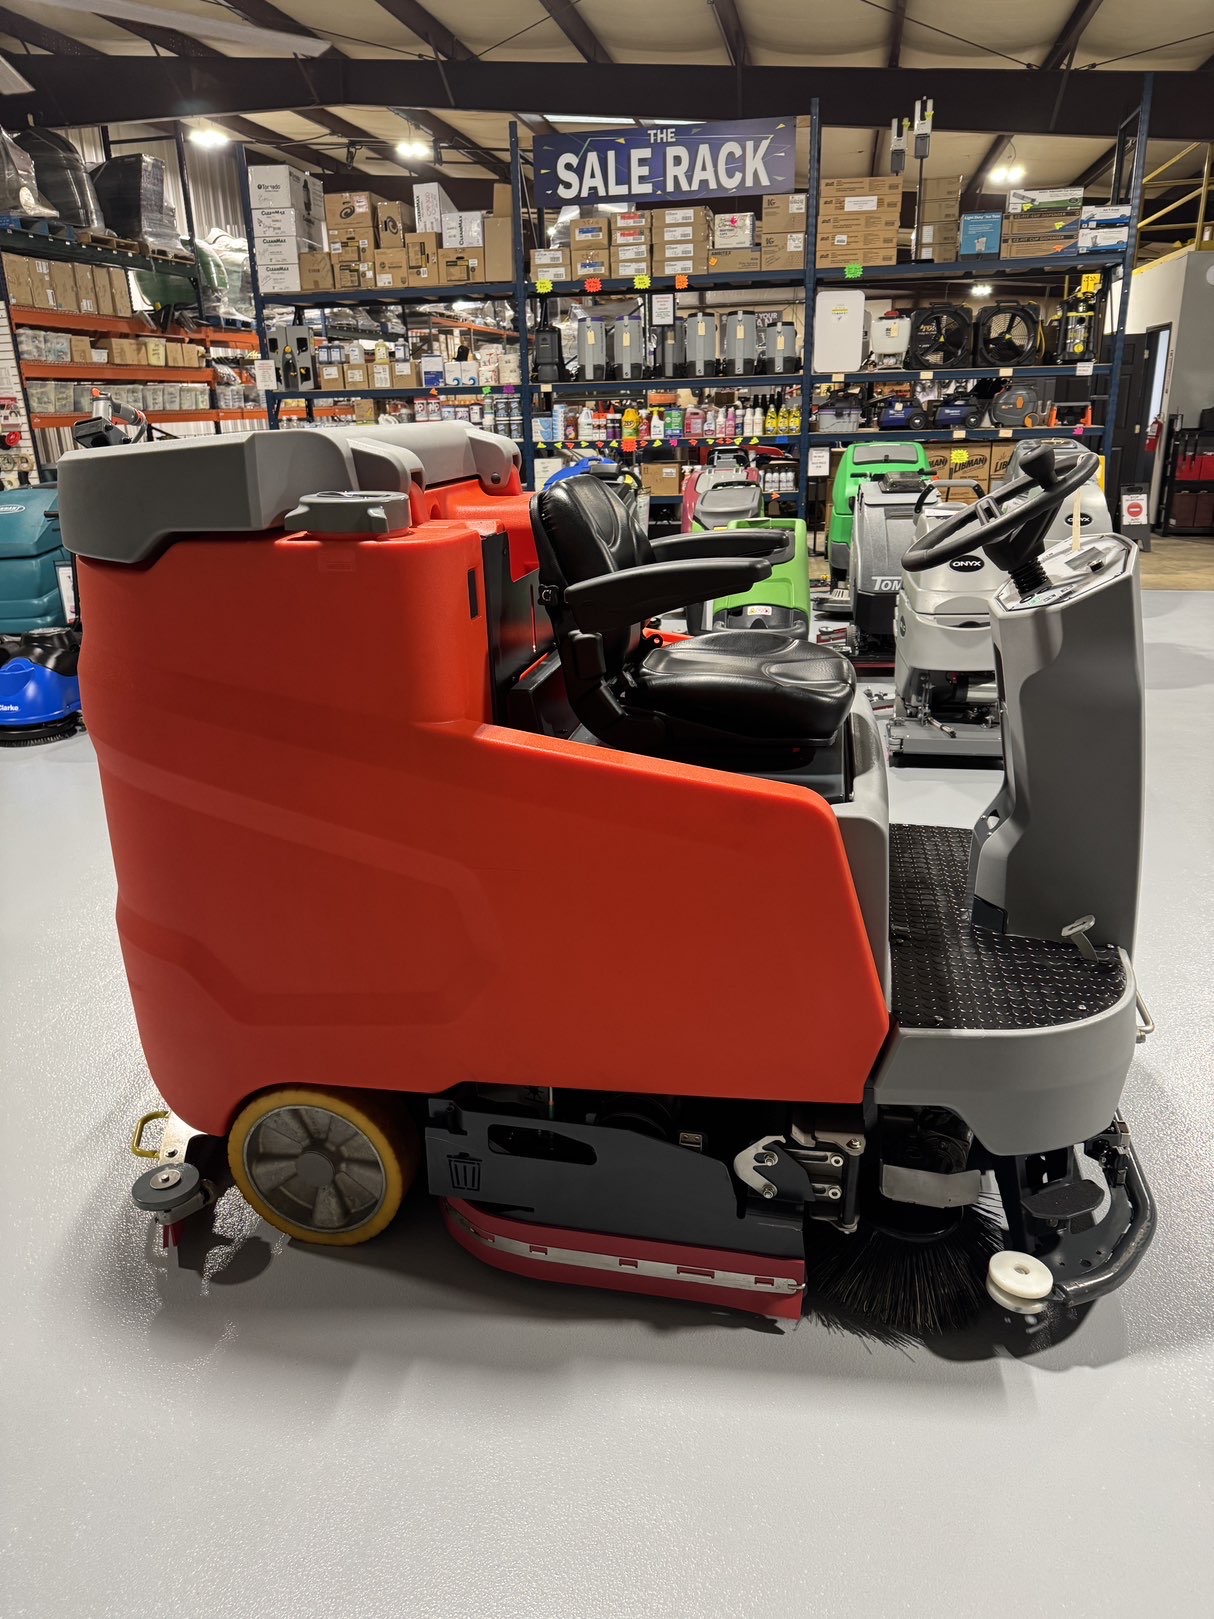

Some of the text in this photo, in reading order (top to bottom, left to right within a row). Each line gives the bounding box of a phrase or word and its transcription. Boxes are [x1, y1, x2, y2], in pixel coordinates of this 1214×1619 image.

[648, 128, 676, 144] THE
[557, 139, 771, 199] SALE RACK
[758, 312, 778, 321] YOUR
